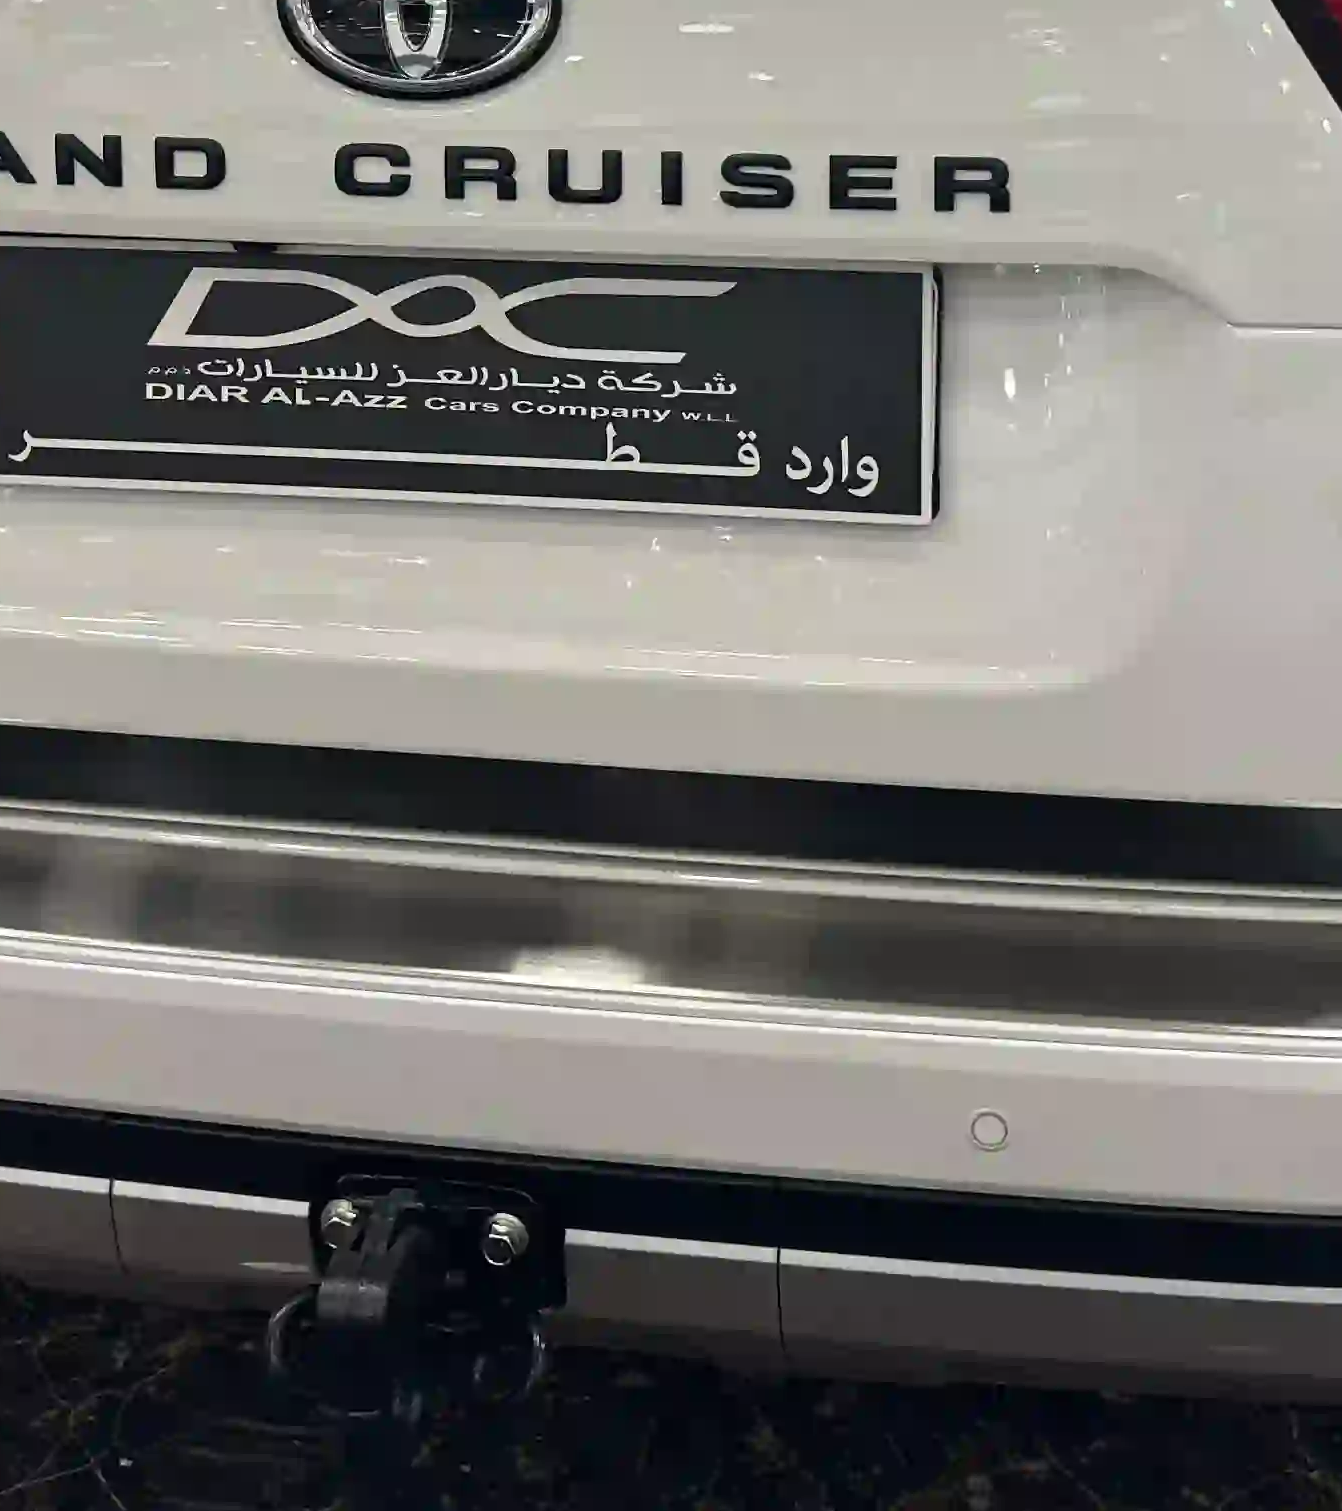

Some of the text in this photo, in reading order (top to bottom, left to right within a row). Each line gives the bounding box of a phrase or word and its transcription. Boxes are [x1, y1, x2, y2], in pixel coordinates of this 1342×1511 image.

[335, 143, 1010, 213] CRUISER
[197, 357, 379, 384] للسيارات
[598, 370, 737, 398] شركة
[145, 383, 250, 403] DIAR
[424, 396, 500, 413] Cars
[511, 400, 671, 422] Company
[8, 421, 879, 498] وارد قطر
